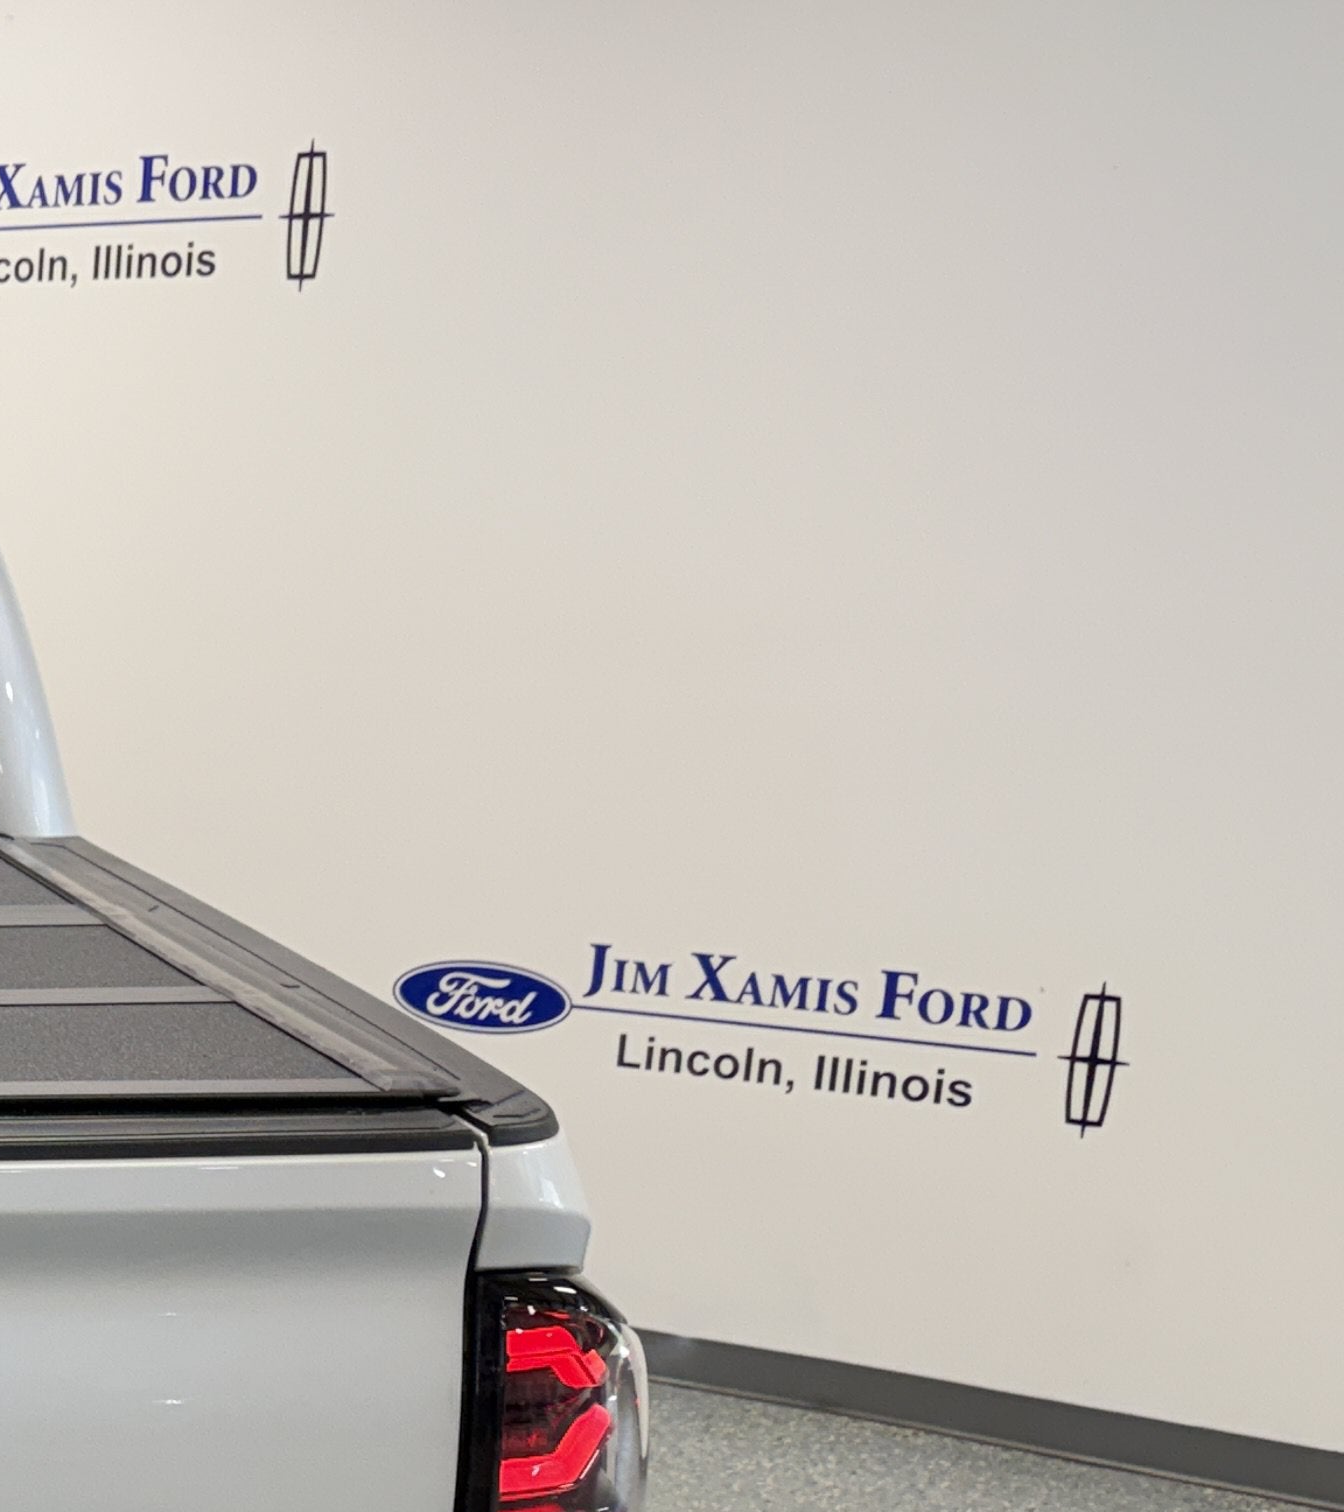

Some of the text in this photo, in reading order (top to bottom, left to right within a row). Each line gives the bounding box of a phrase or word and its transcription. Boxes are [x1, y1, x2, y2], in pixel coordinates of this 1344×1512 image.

[137, 154, 258, 203] FORD
[92, 241, 216, 280] Illinois
[424, 968, 534, 1027] Ford
[583, 943, 1033, 1032] JIM XAMIS FORD
[616, 1033, 974, 1109] Lincoln, Illinois
